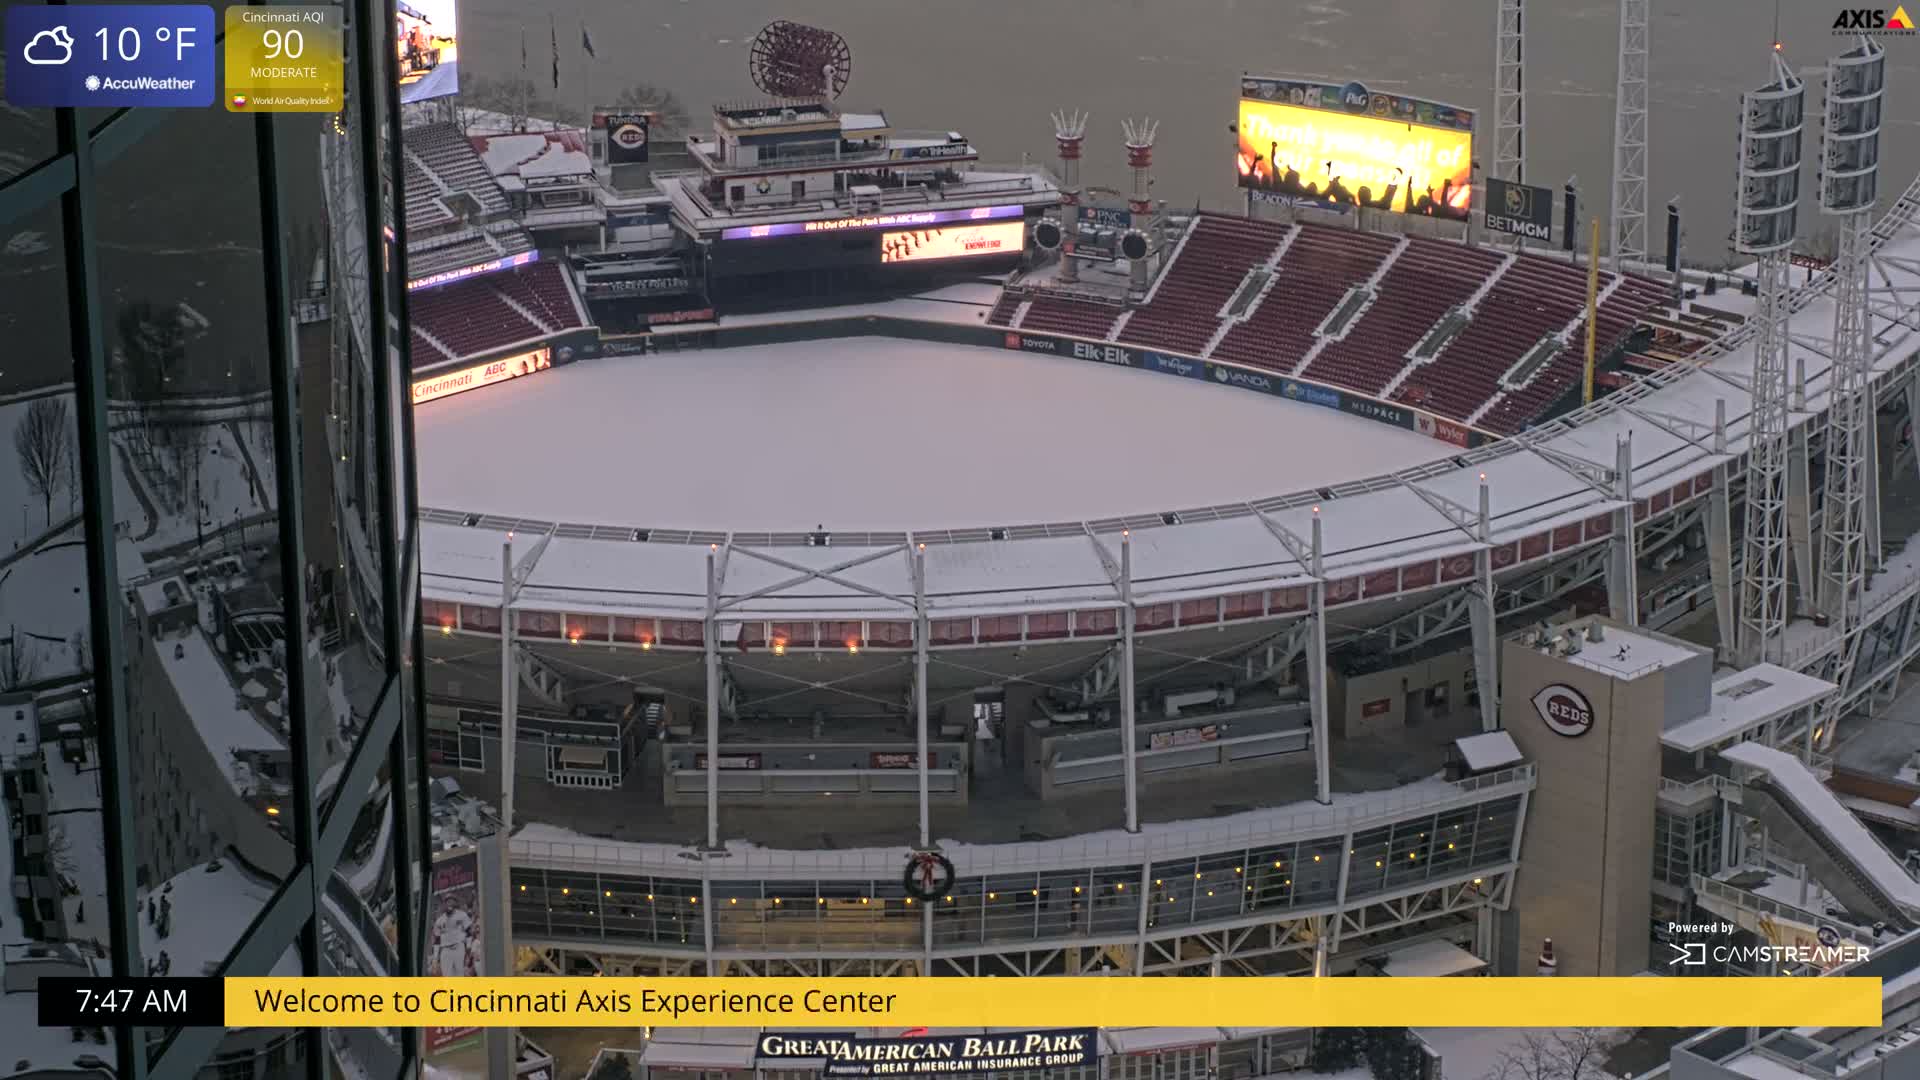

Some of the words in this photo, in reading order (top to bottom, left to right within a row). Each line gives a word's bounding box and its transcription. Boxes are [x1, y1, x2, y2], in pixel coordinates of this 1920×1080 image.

[607, 115, 647, 125] TUNDRA
[621, 131, 644, 142] REDS
[1246, 114, 1317, 148] Thank
[1437, 145, 1465, 168] of
[1252, 189, 1292, 207] BEACON
[805, 223, 817, 231] Hit
[825, 221, 838, 230] Out
[839, 220, 849, 229] Of
[849, 219, 861, 228] The
[862, 218, 878, 227] Park
[896, 216, 911, 225] ABC
[1097, 210, 1121, 222] PNC
[1487, 214, 1549, 239] BETMGM
[1023, 338, 1055, 350] TOYOTA
[484, 362, 507, 376] ABC
[414, 372, 473, 398] Cincinnati
[1229, 371, 1271, 389] VANDA
[1351, 401, 1401, 421] MEDPACE
[1439, 424, 1465, 440] Wyler
[1549, 701, 1590, 725] REDS
[761, 1036, 842, 1056] GREAT
[834, 1041, 955, 1061] AMERICAN
[873, 1062, 909, 1074] GREAT
[913, 1060, 972, 1072] AMERICAN
[977, 1055, 1041, 1070] INSURANCE
[1045, 1052, 1084, 1066] GROUP
